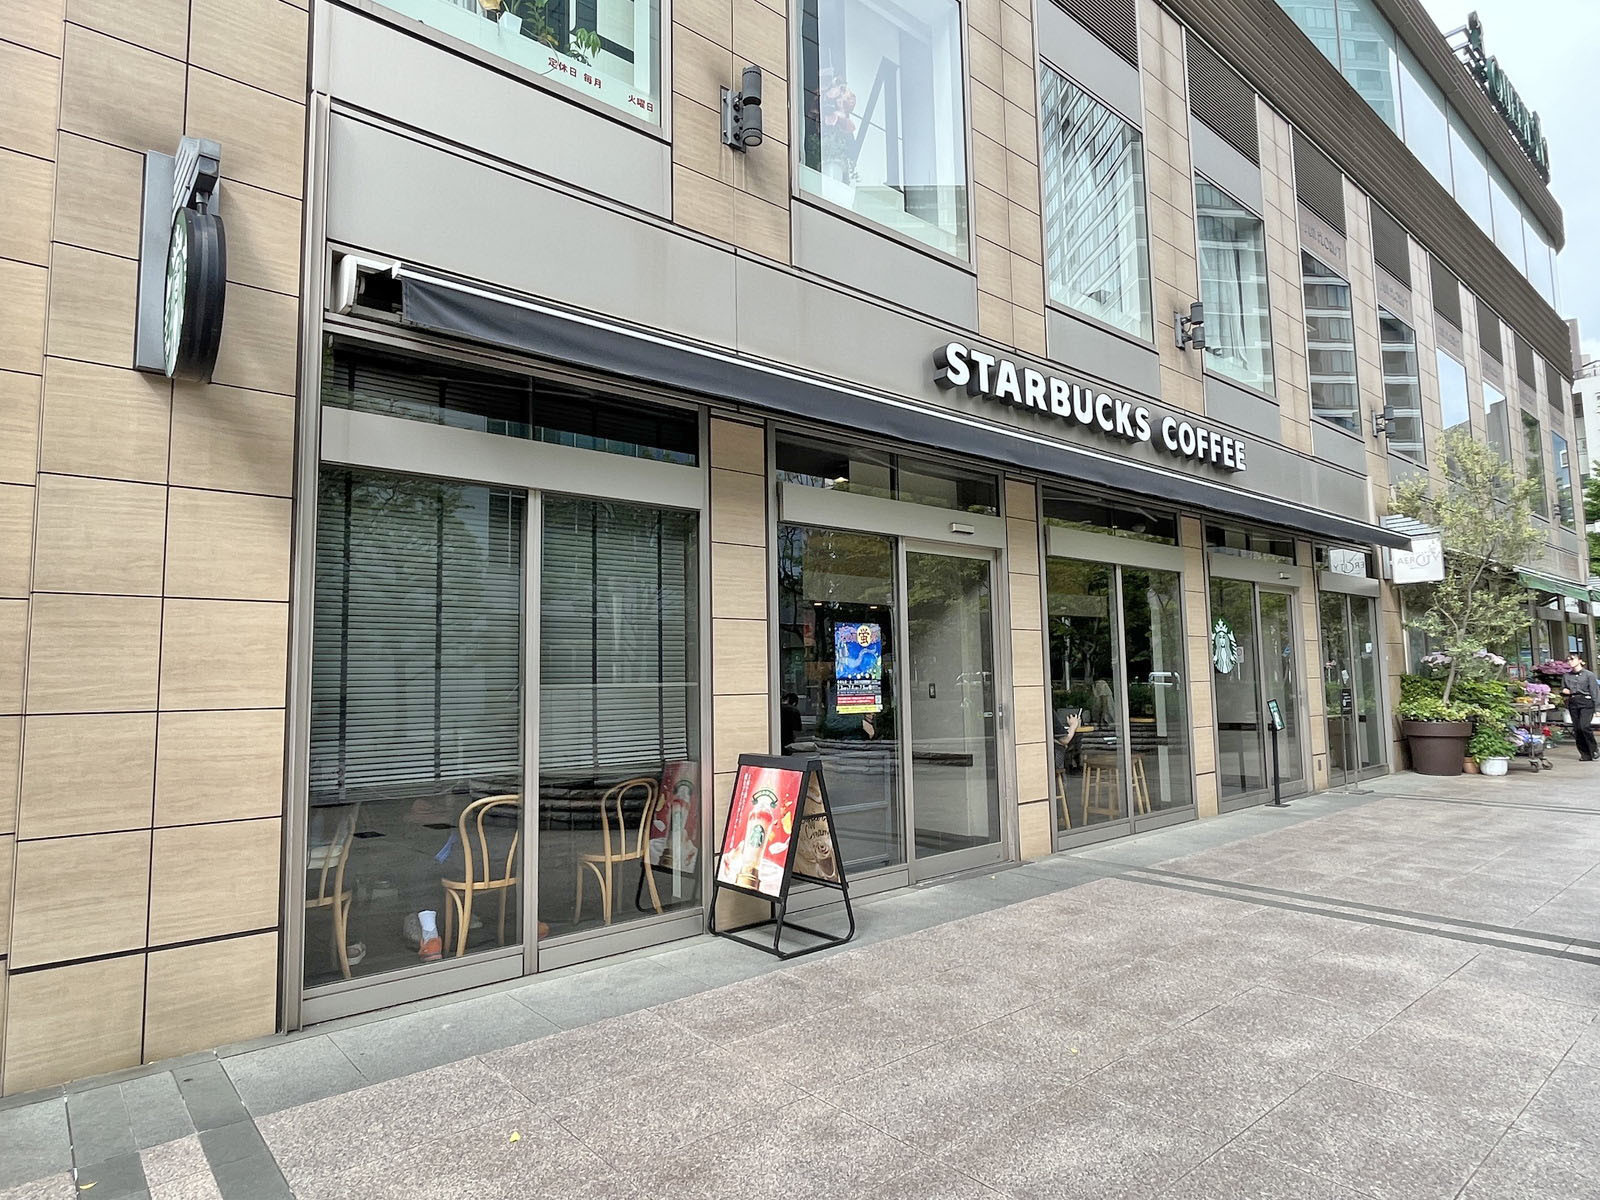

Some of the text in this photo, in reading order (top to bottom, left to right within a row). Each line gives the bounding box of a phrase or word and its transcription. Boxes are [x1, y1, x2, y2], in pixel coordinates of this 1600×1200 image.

[548, 57, 654, 112] 定休日 毎月 火曜日
[944, 341, 1247, 472] STARBUCKS COFFEE
